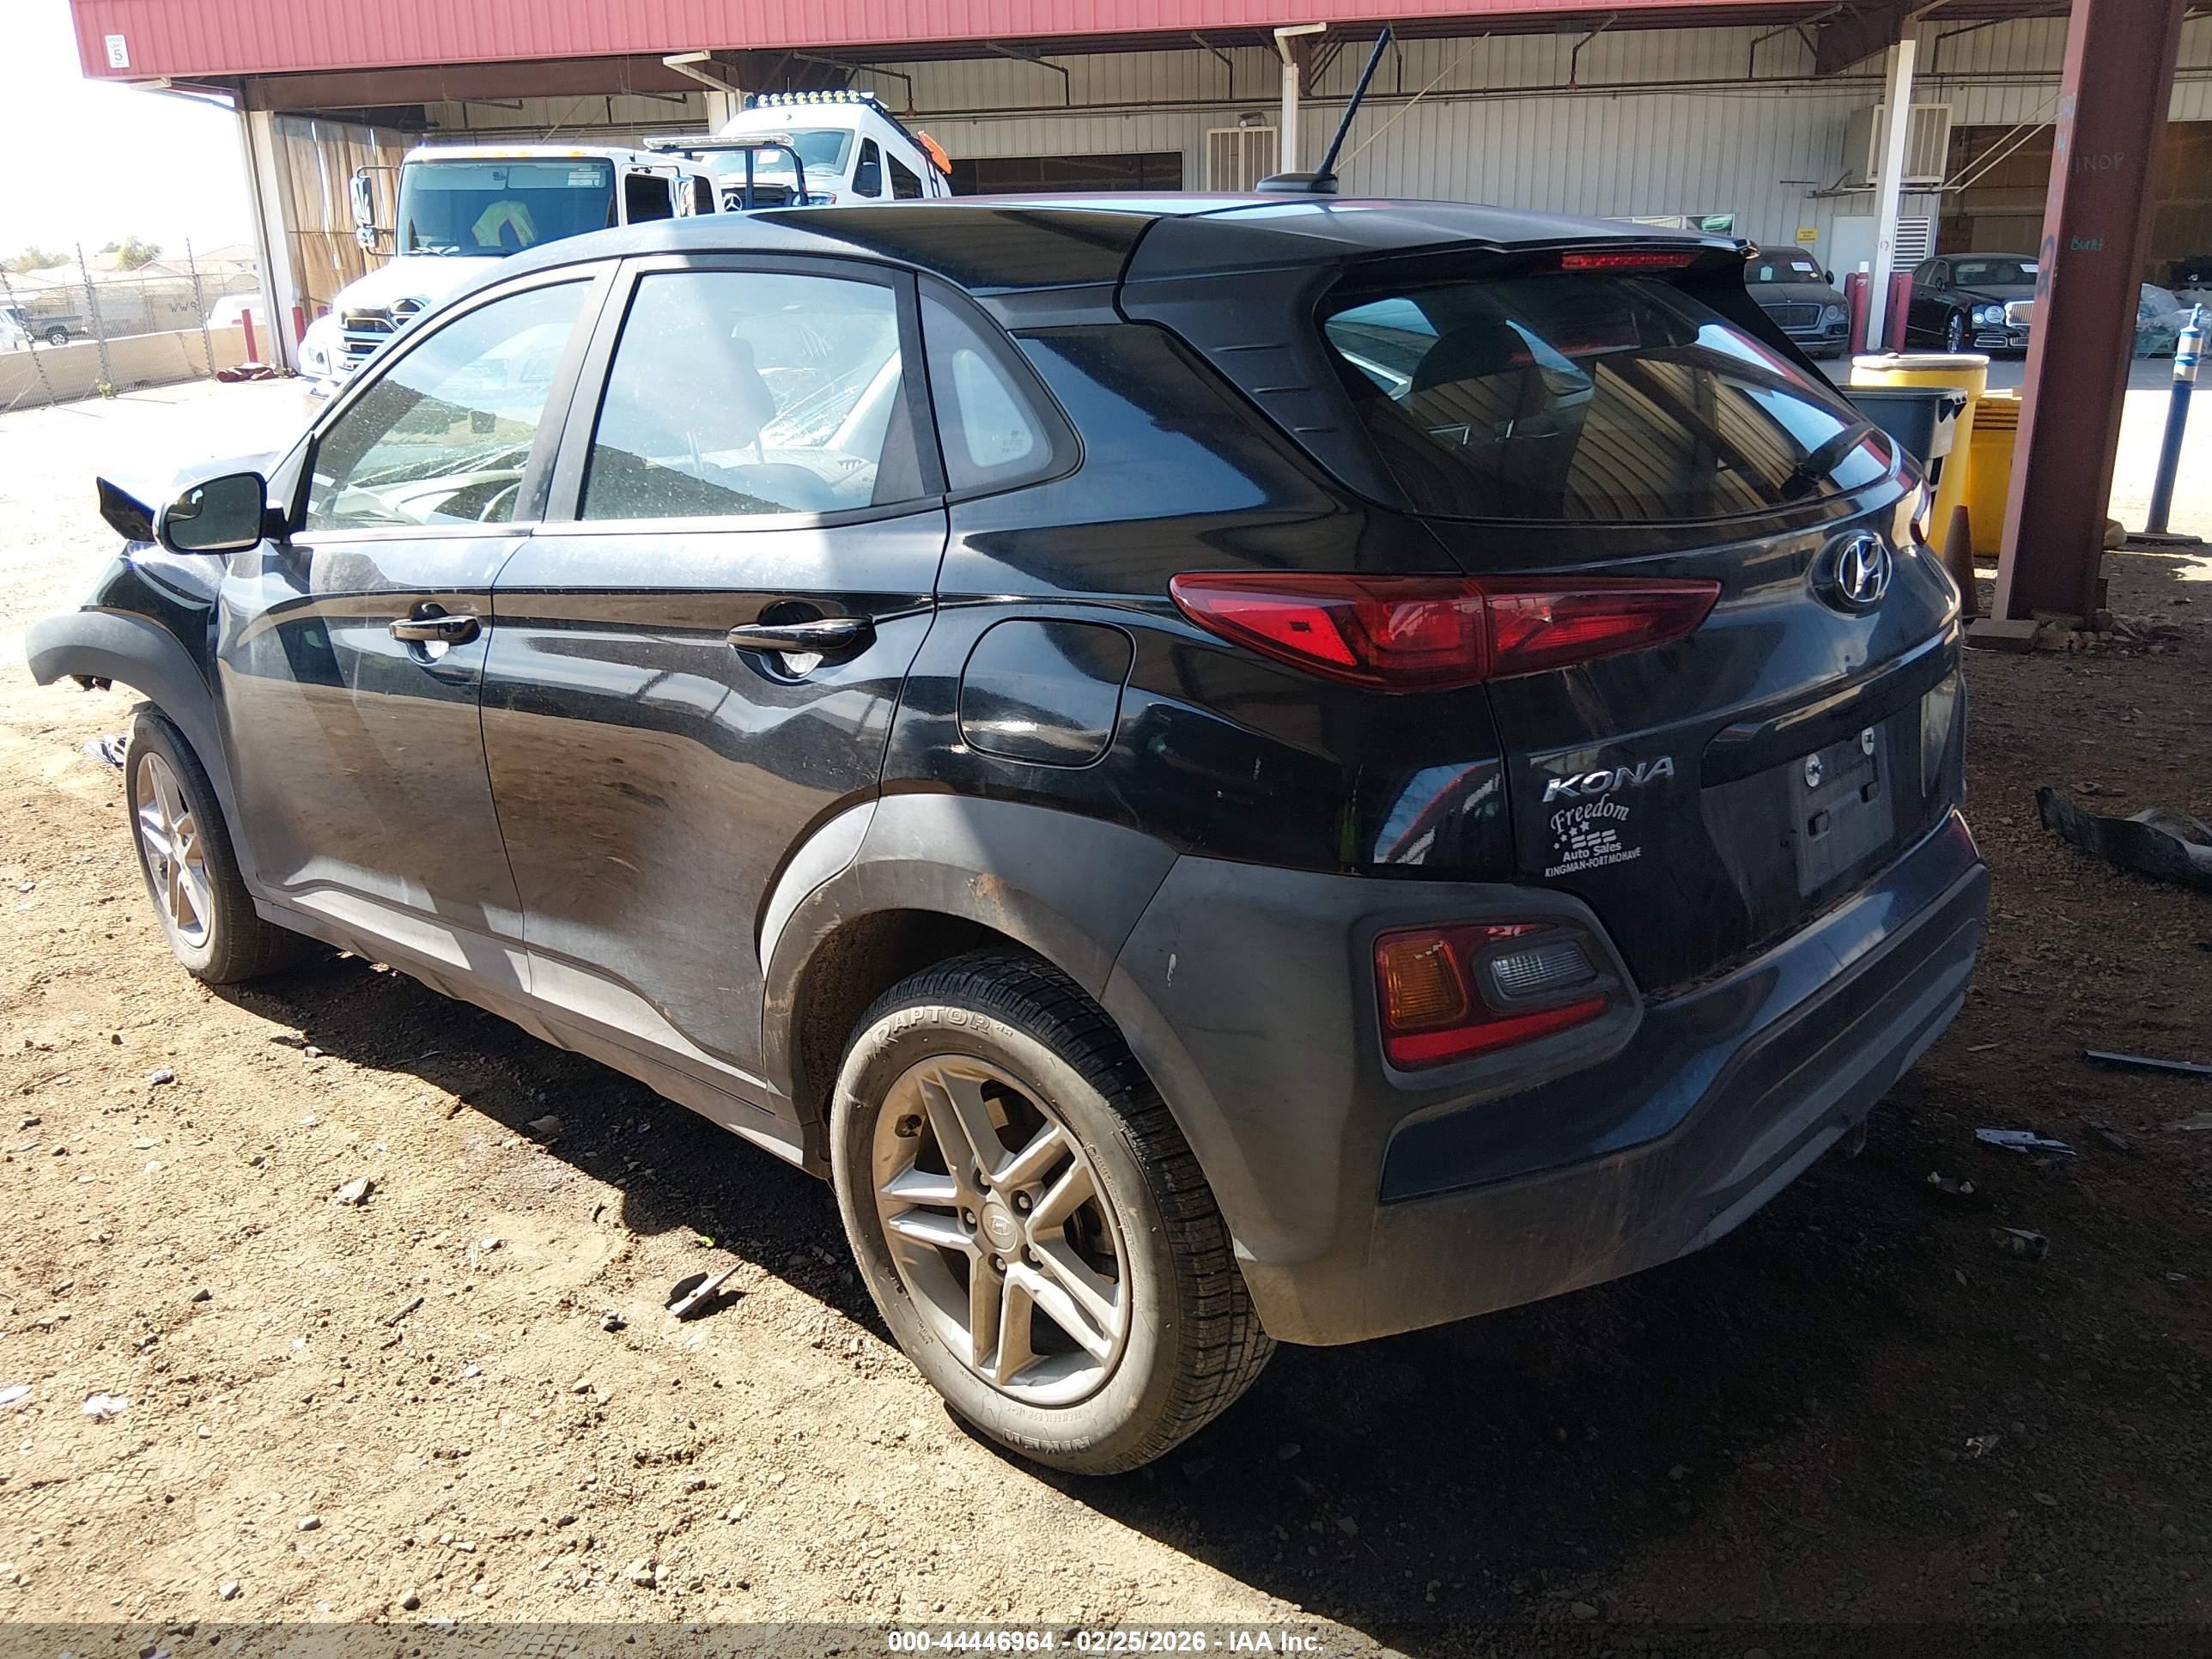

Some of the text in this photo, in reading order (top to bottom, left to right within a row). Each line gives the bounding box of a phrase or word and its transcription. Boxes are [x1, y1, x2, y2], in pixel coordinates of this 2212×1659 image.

[113, 49, 123, 61] 5
[1542, 756, 1674, 802] KONA
[1550, 793, 1629, 835] Freedom
[1563, 842, 1622, 862] Auto Sales
[1608, 847, 1641, 865] MOHAVE
[871, 1006, 990, 1053] RAPTOR
